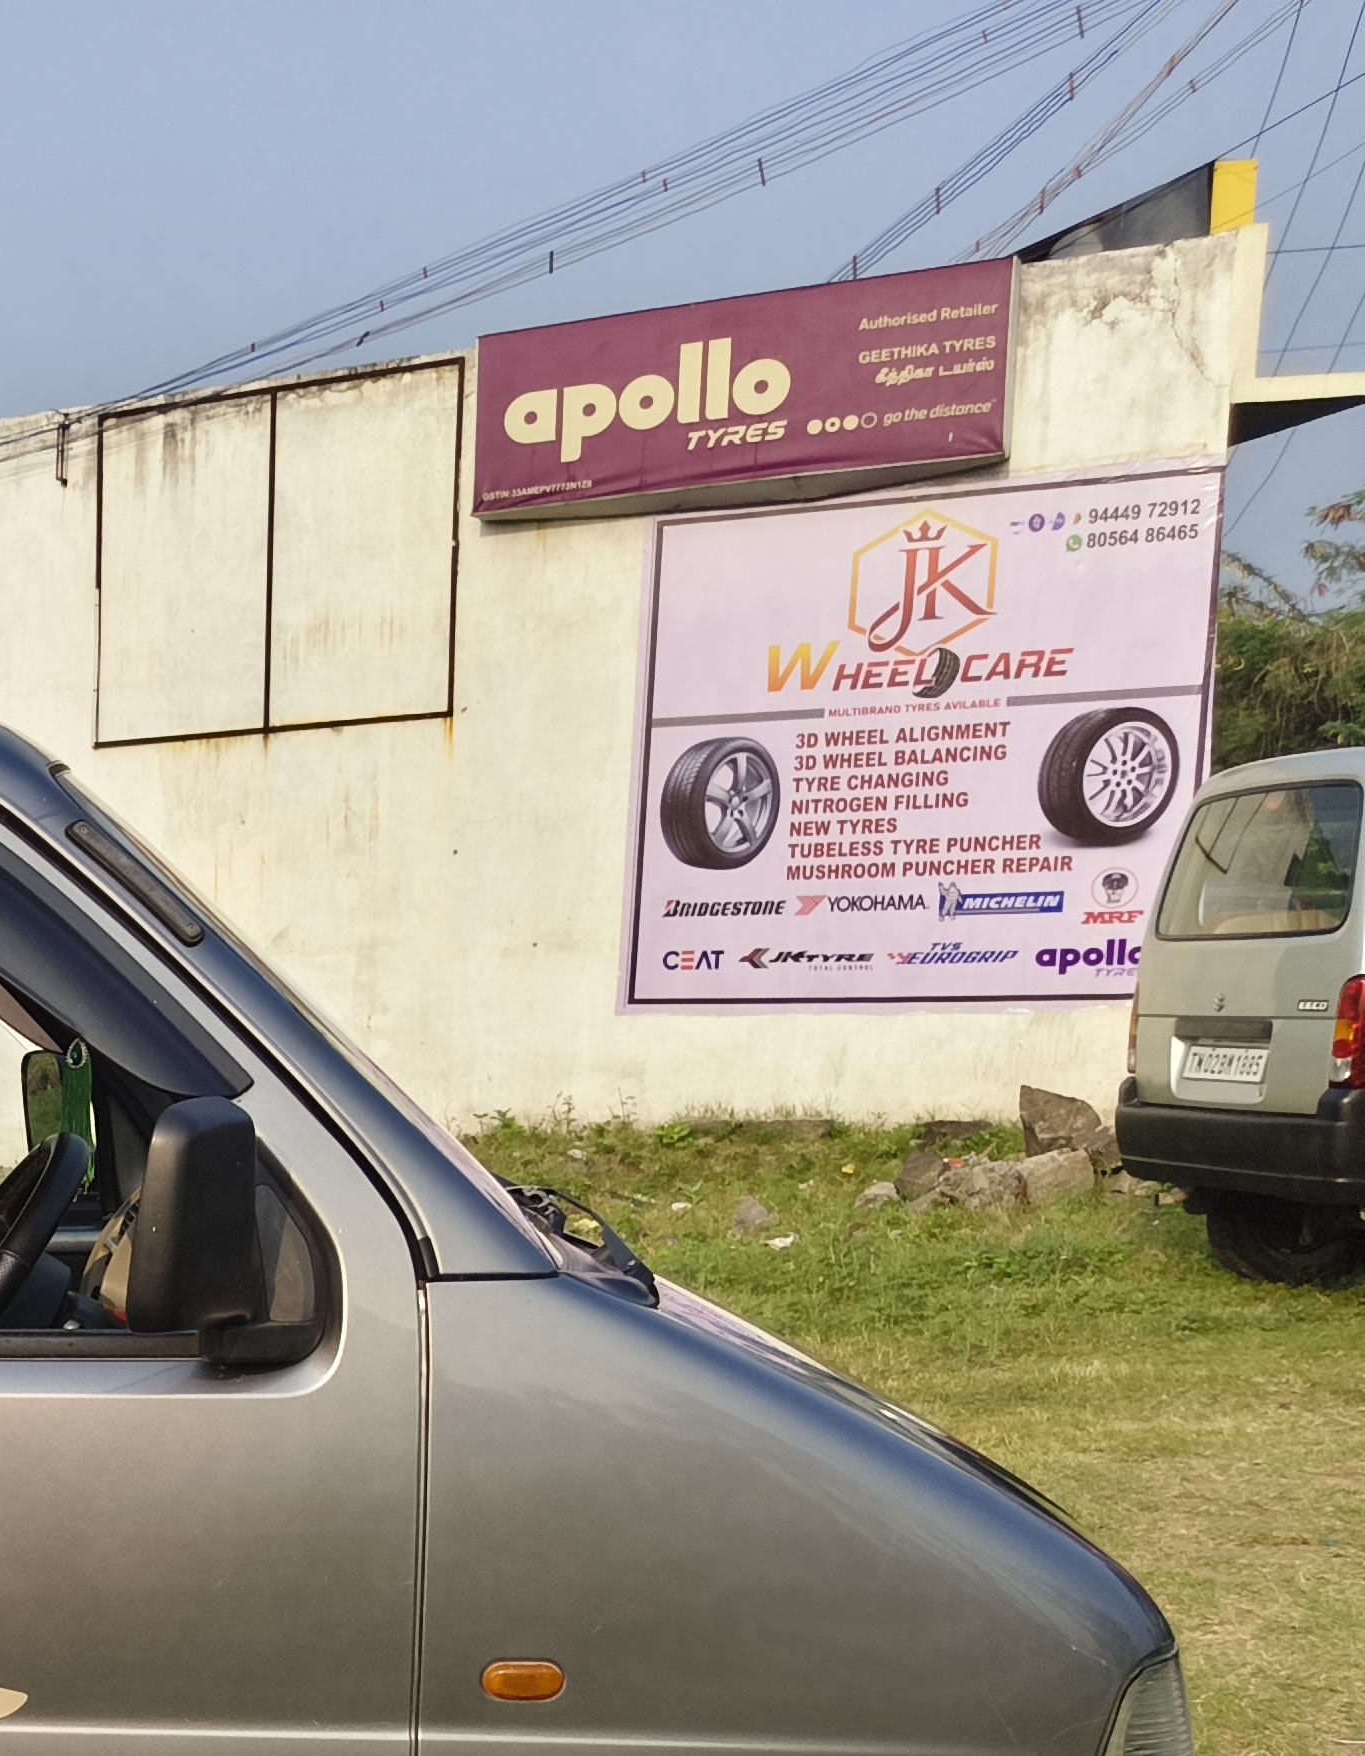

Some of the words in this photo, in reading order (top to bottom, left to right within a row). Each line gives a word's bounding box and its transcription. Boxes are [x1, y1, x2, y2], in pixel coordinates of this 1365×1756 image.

[858, 309, 937, 331] Authorised
[941, 303, 999, 320] Retailer
[858, 343, 939, 364] GEETHIKA
[943, 335, 996, 354] TYRES
[504, 338, 791, 463] apollo
[883, 410, 902, 426] go
[904, 406, 927, 421] the
[929, 400, 992, 419] distance
[687, 419, 788, 450] TYRES
[1088, 504, 1141, 524] 94449
[1148, 498, 1201, 518] 72912
[1086, 529, 1139, 548] 80564
[1145, 523, 1199, 543] 86465
[868, 543, 998, 653] JK
[768, 640, 935, 693] WHEEL
[960, 647, 1074, 683] CARE
[828, 704, 901, 717] MULTIBRAND
[905, 701, 941, 713] TYRES
[944, 697, 1001, 710] AVILABLE
[795, 732, 819, 749] 3D
[824, 729, 890, 747] WHEEL
[894, 721, 1011, 744] ALIGNMENT
[794, 754, 817, 771] 3D
[823, 750, 888, 769] WHEEL
[894, 744, 1007, 766] BALANCING
[793, 775, 841, 793] TYRE
[847, 770, 949, 791] CHANGING
[791, 795, 888, 815] NITROGEN
[894, 791, 969, 811] FILLING
[789, 820, 831, 837] NEW
[837, 817, 898, 835] TYRES
[788, 839, 884, 859] TUBELESS
[890, 837, 940, 856] TYRE
[946, 833, 1042, 854] PUNCHER
[786, 861, 896, 881] MUSHROOM
[902, 857, 995, 877] PUNCHER
[1002, 854, 1073, 873] REPAIR
[662, 899, 786, 918] BRIDGESTONE
[827, 894, 927, 913] YOKOHAMA
[962, 893, 1061, 910] MICHELIN
[1081, 910, 1144, 925] MRF
[907, 950, 1019, 965] EUROGRIP
[930, 941, 963, 951] TVS
[662, 950, 725, 971] CEAT
[1095, 967, 1138, 977] TYRE
